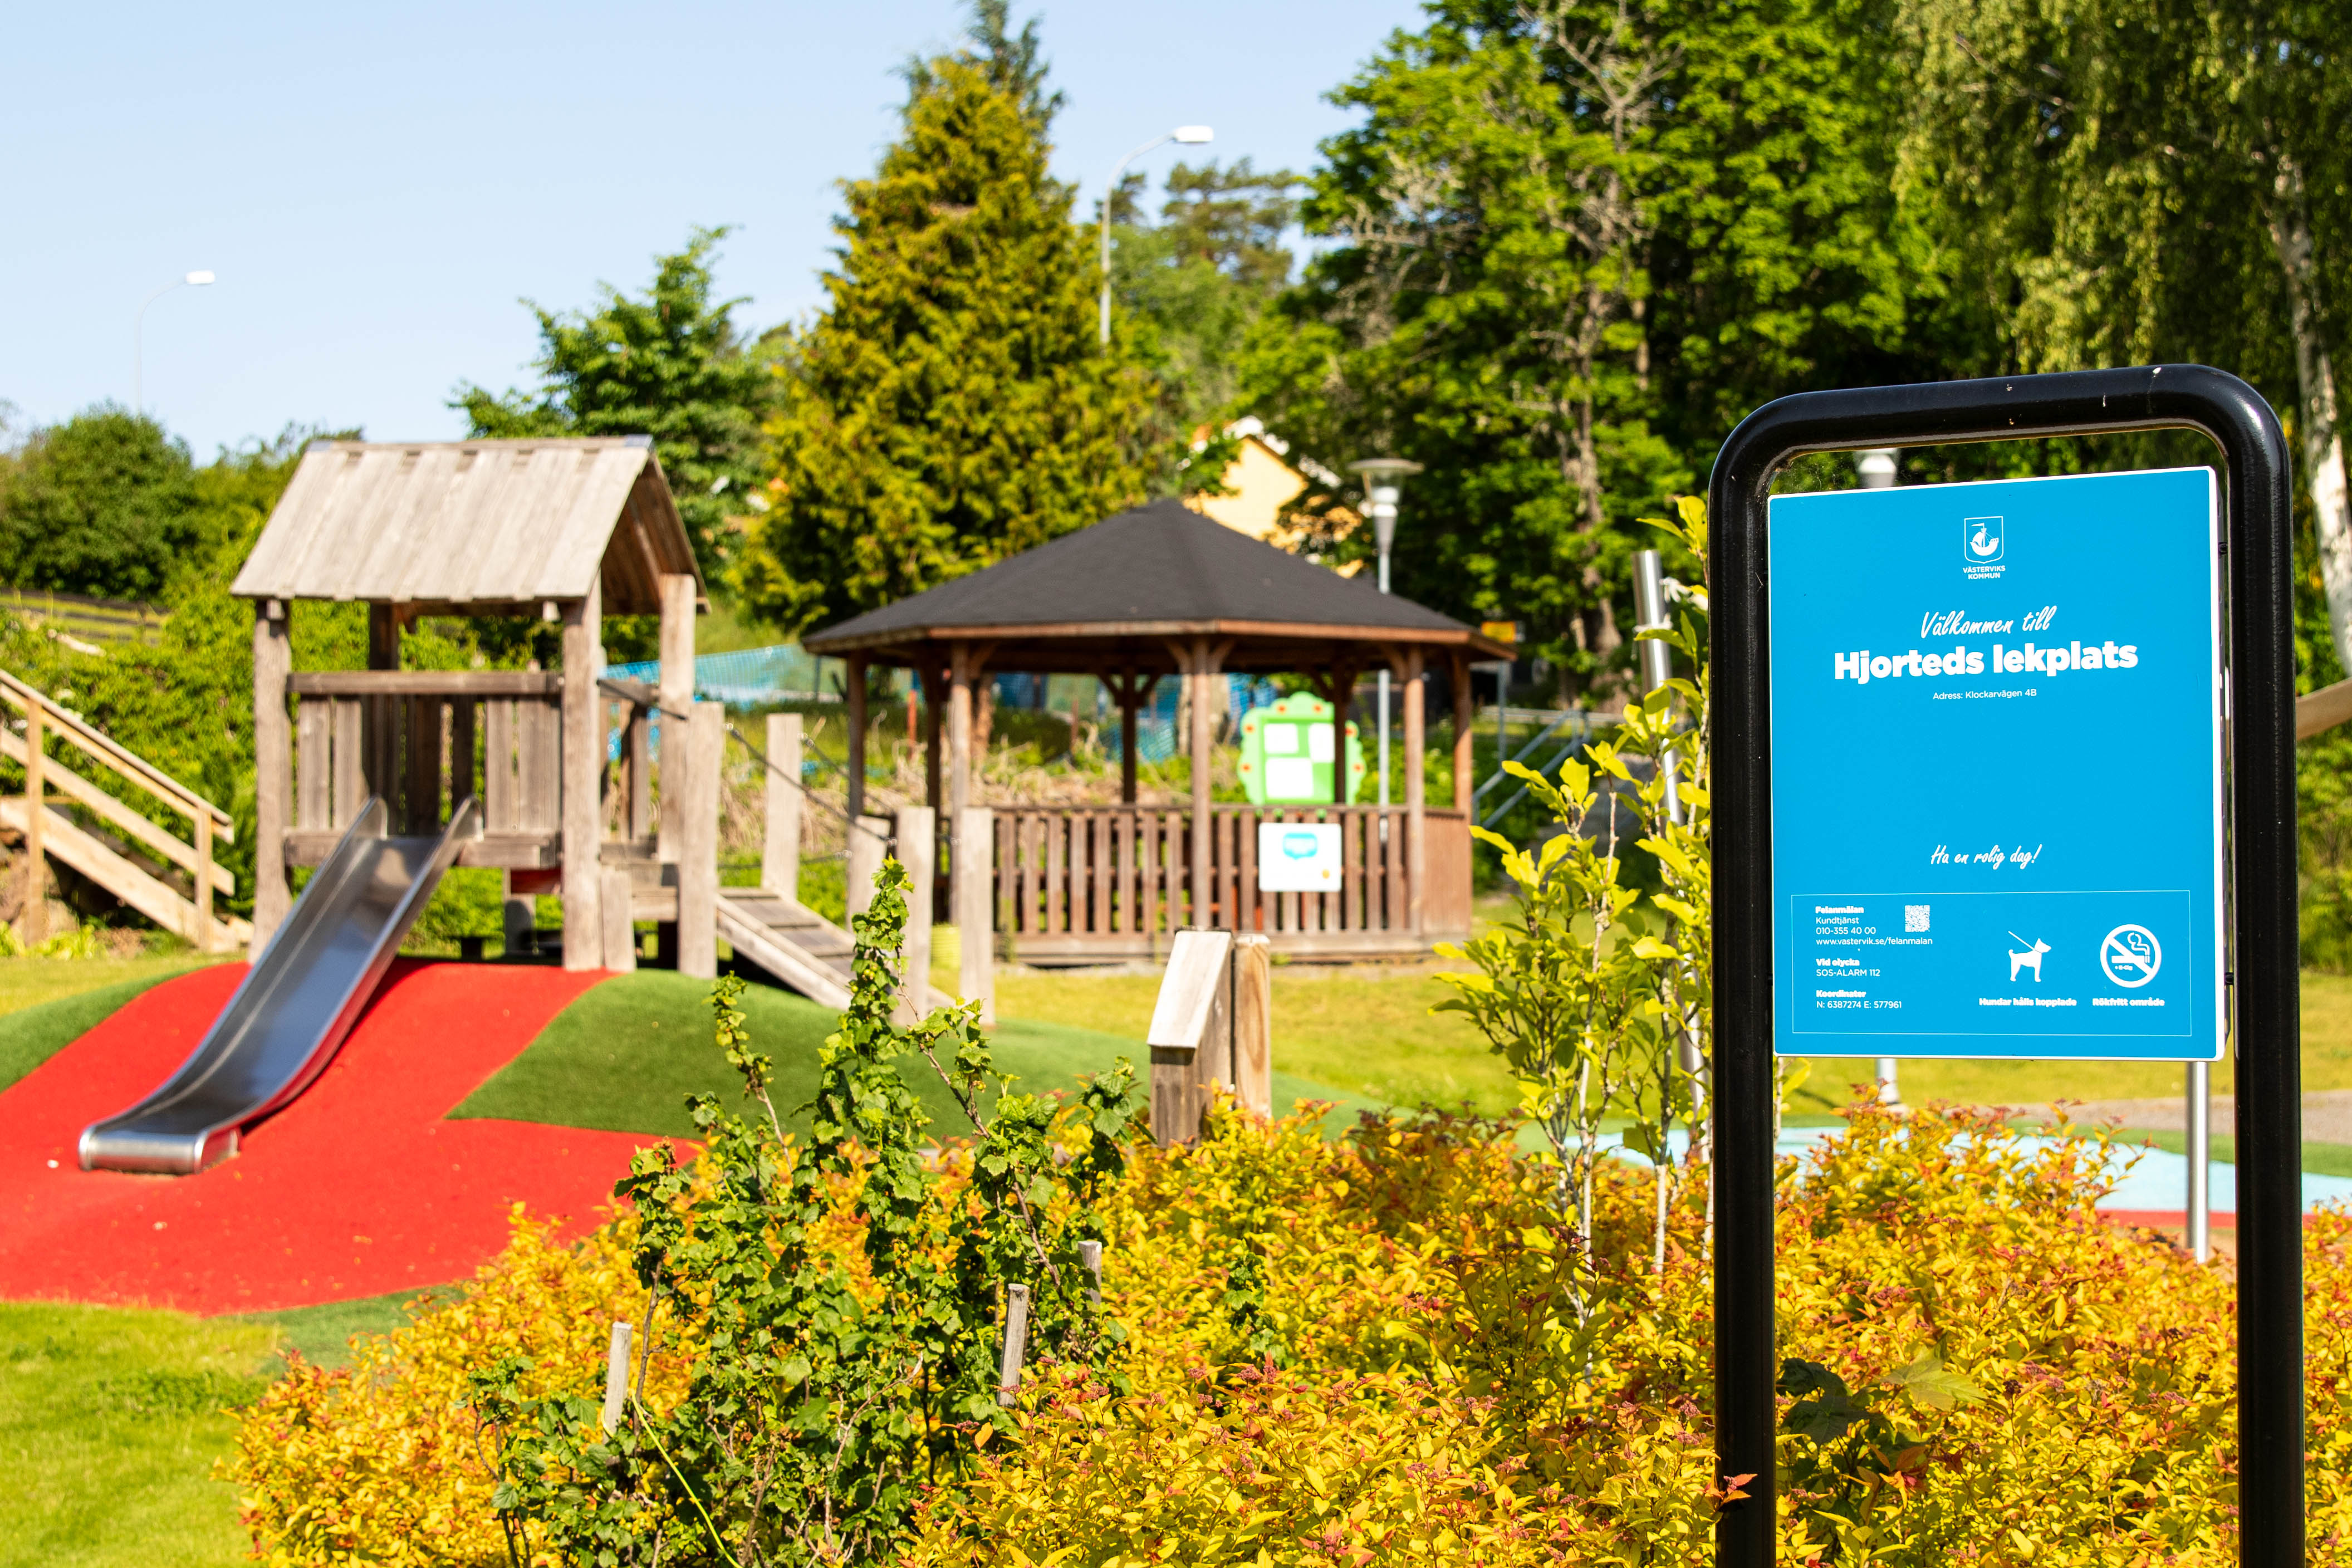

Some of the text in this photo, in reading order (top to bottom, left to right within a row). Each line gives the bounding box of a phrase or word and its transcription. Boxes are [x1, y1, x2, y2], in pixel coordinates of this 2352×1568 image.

[1963, 565, 2006, 574] VÄSTERVIKS
[1921, 606, 2057, 638] Välkommen till
[1835, 641, 2138, 684] Hjorteds lekplats
[1931, 844, 2042, 870] Ha en rolig dag!
[1832, 958, 1860, 967] olycka
[2013, 997, 2034, 1006] hålls
[2036, 998, 2077, 1007] kopplade
[2129, 997, 2165, 1006] område
